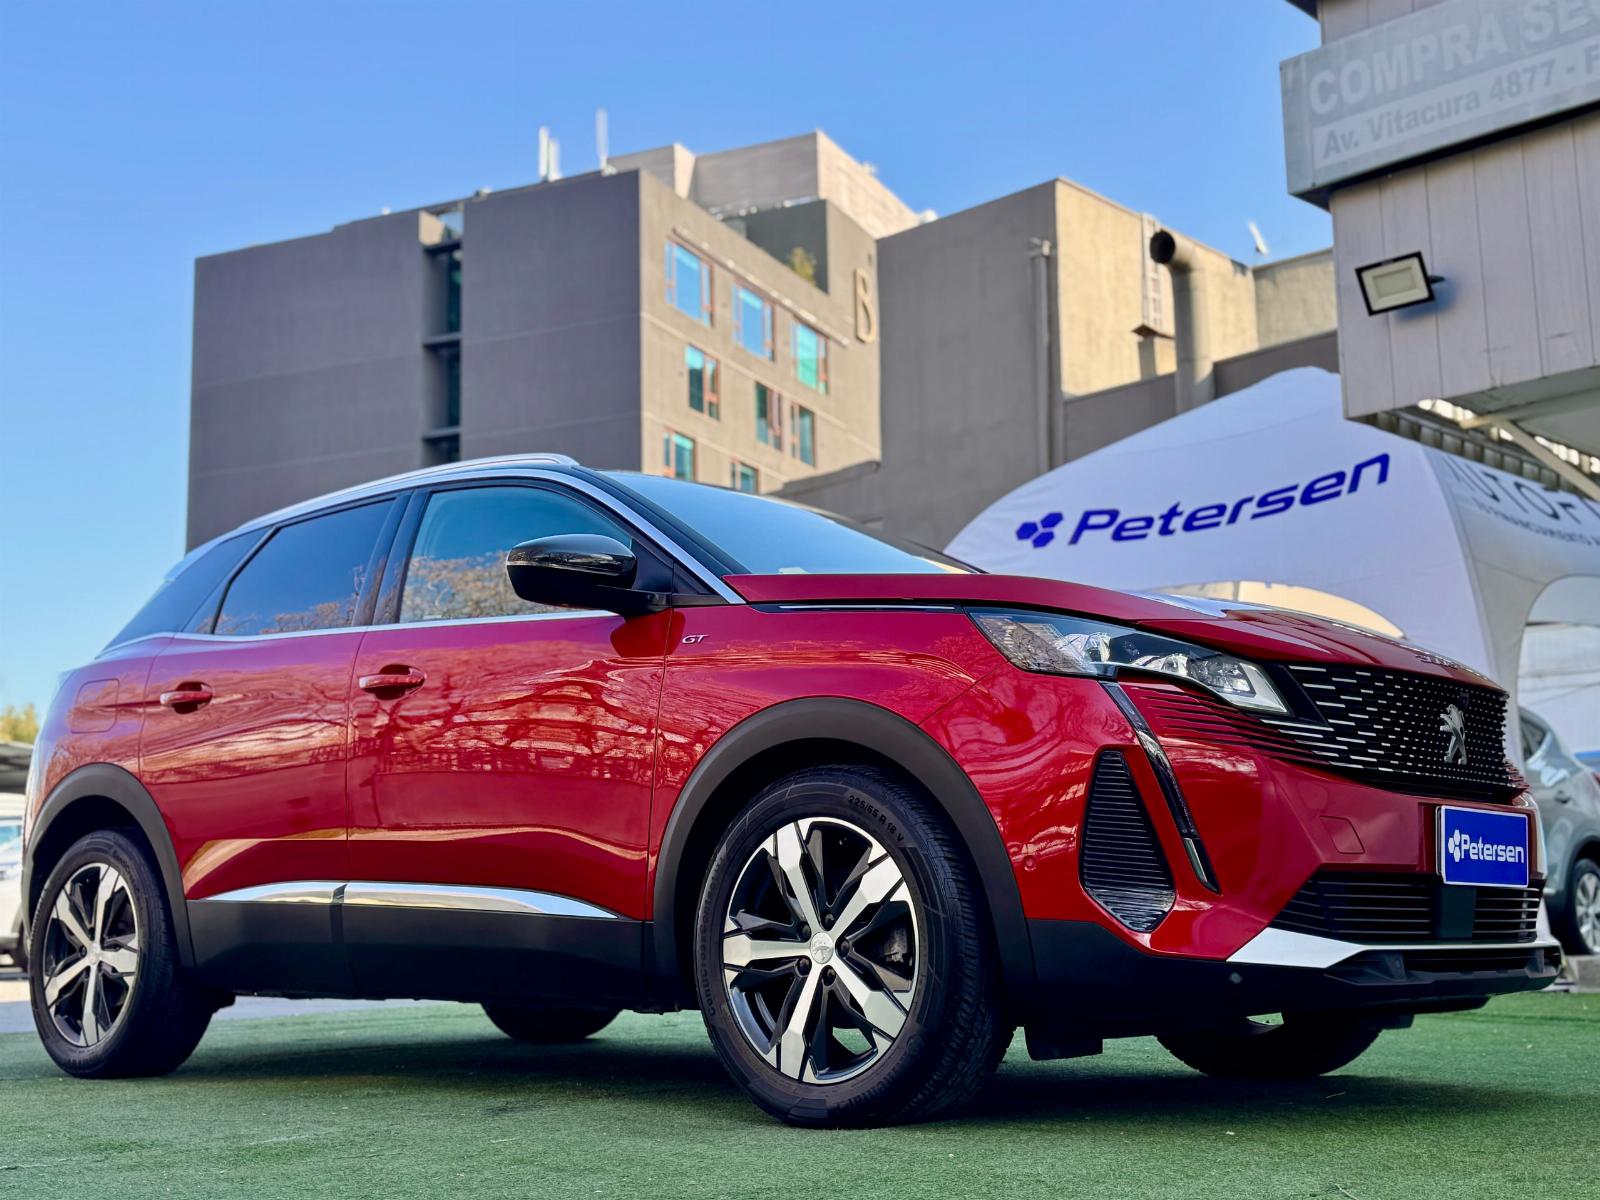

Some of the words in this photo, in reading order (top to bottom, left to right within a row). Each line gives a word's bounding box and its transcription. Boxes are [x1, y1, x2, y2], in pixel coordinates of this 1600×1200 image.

[1310, 11, 1507, 115] COMPRA
[1522, 0, 1600, 42] SE
[1323, 129, 1359, 158] Av.
[1368, 89, 1481, 142] Vitacura
[1488, 58, 1556, 104] 4877
[853, 268, 878, 343] B
[1068, 453, 1390, 545] Petersen
[682, 634, 709, 644] GT
[848, 795, 879, 817] 225/55
[880, 814, 887, 824] R
[1461, 833, 1525, 864] Petersen
